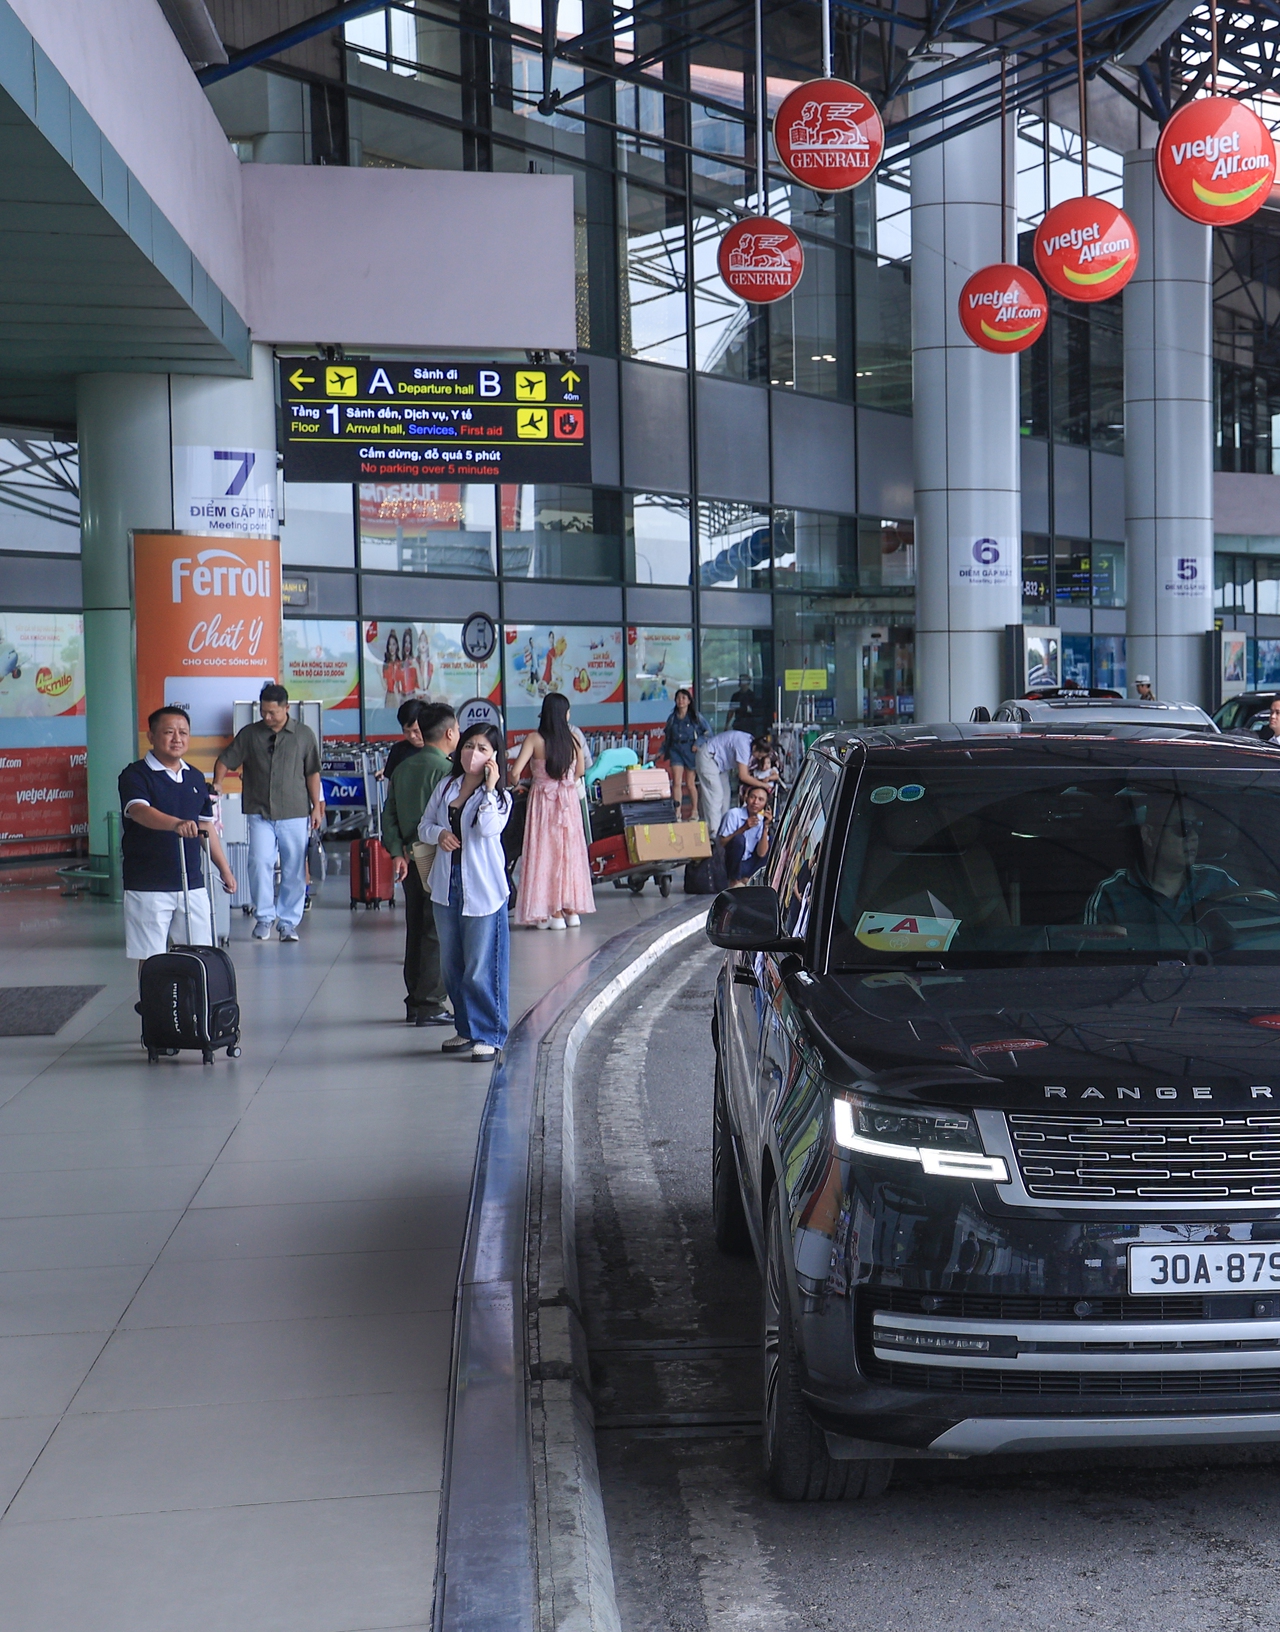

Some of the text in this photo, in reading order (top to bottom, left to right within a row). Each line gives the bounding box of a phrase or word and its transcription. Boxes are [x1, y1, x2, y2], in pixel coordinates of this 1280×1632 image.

[791, 152, 870, 169] GENERALI
[730, 273, 792, 286] GENERALI
[369, 368, 501, 397] A Sảnh đi B
[398, 382, 474, 397] Departure hall
[563, 393, 580, 401] 40m
[291, 404, 340, 435] Tầng 1
[346, 406, 473, 422] Sảnh đến, Dịch vụ, Y tế
[291, 422, 320, 433] Floor
[346, 424, 503, 437] Arrival hall, Services, First aid
[359, 447, 501, 464] Cấm dừng, đỗ quá 5 phút
[214, 451, 255, 496] 7
[361, 464, 500, 477] No parking over 5 minutes
[190, 500, 227, 519] ĐIỂM
[230, 504, 256, 521] GẶP
[209, 520, 268, 532] Meeting point
[972, 538, 1000, 565] 6
[1177, 558, 1198, 580] 5
[171, 554, 271, 604] Ferroli
[188, 613, 264, 656] Chất Ý
[182, 658, 202, 666] CHO
[204, 657, 227, 668] CUỘC
[228, 656, 249, 666] SỐNG
[468, 708, 491, 718] ACV
[330, 786, 357, 798] ACV
[890, 918, 919, 934] A
[1044, 1085, 1213, 1100] RANGE
